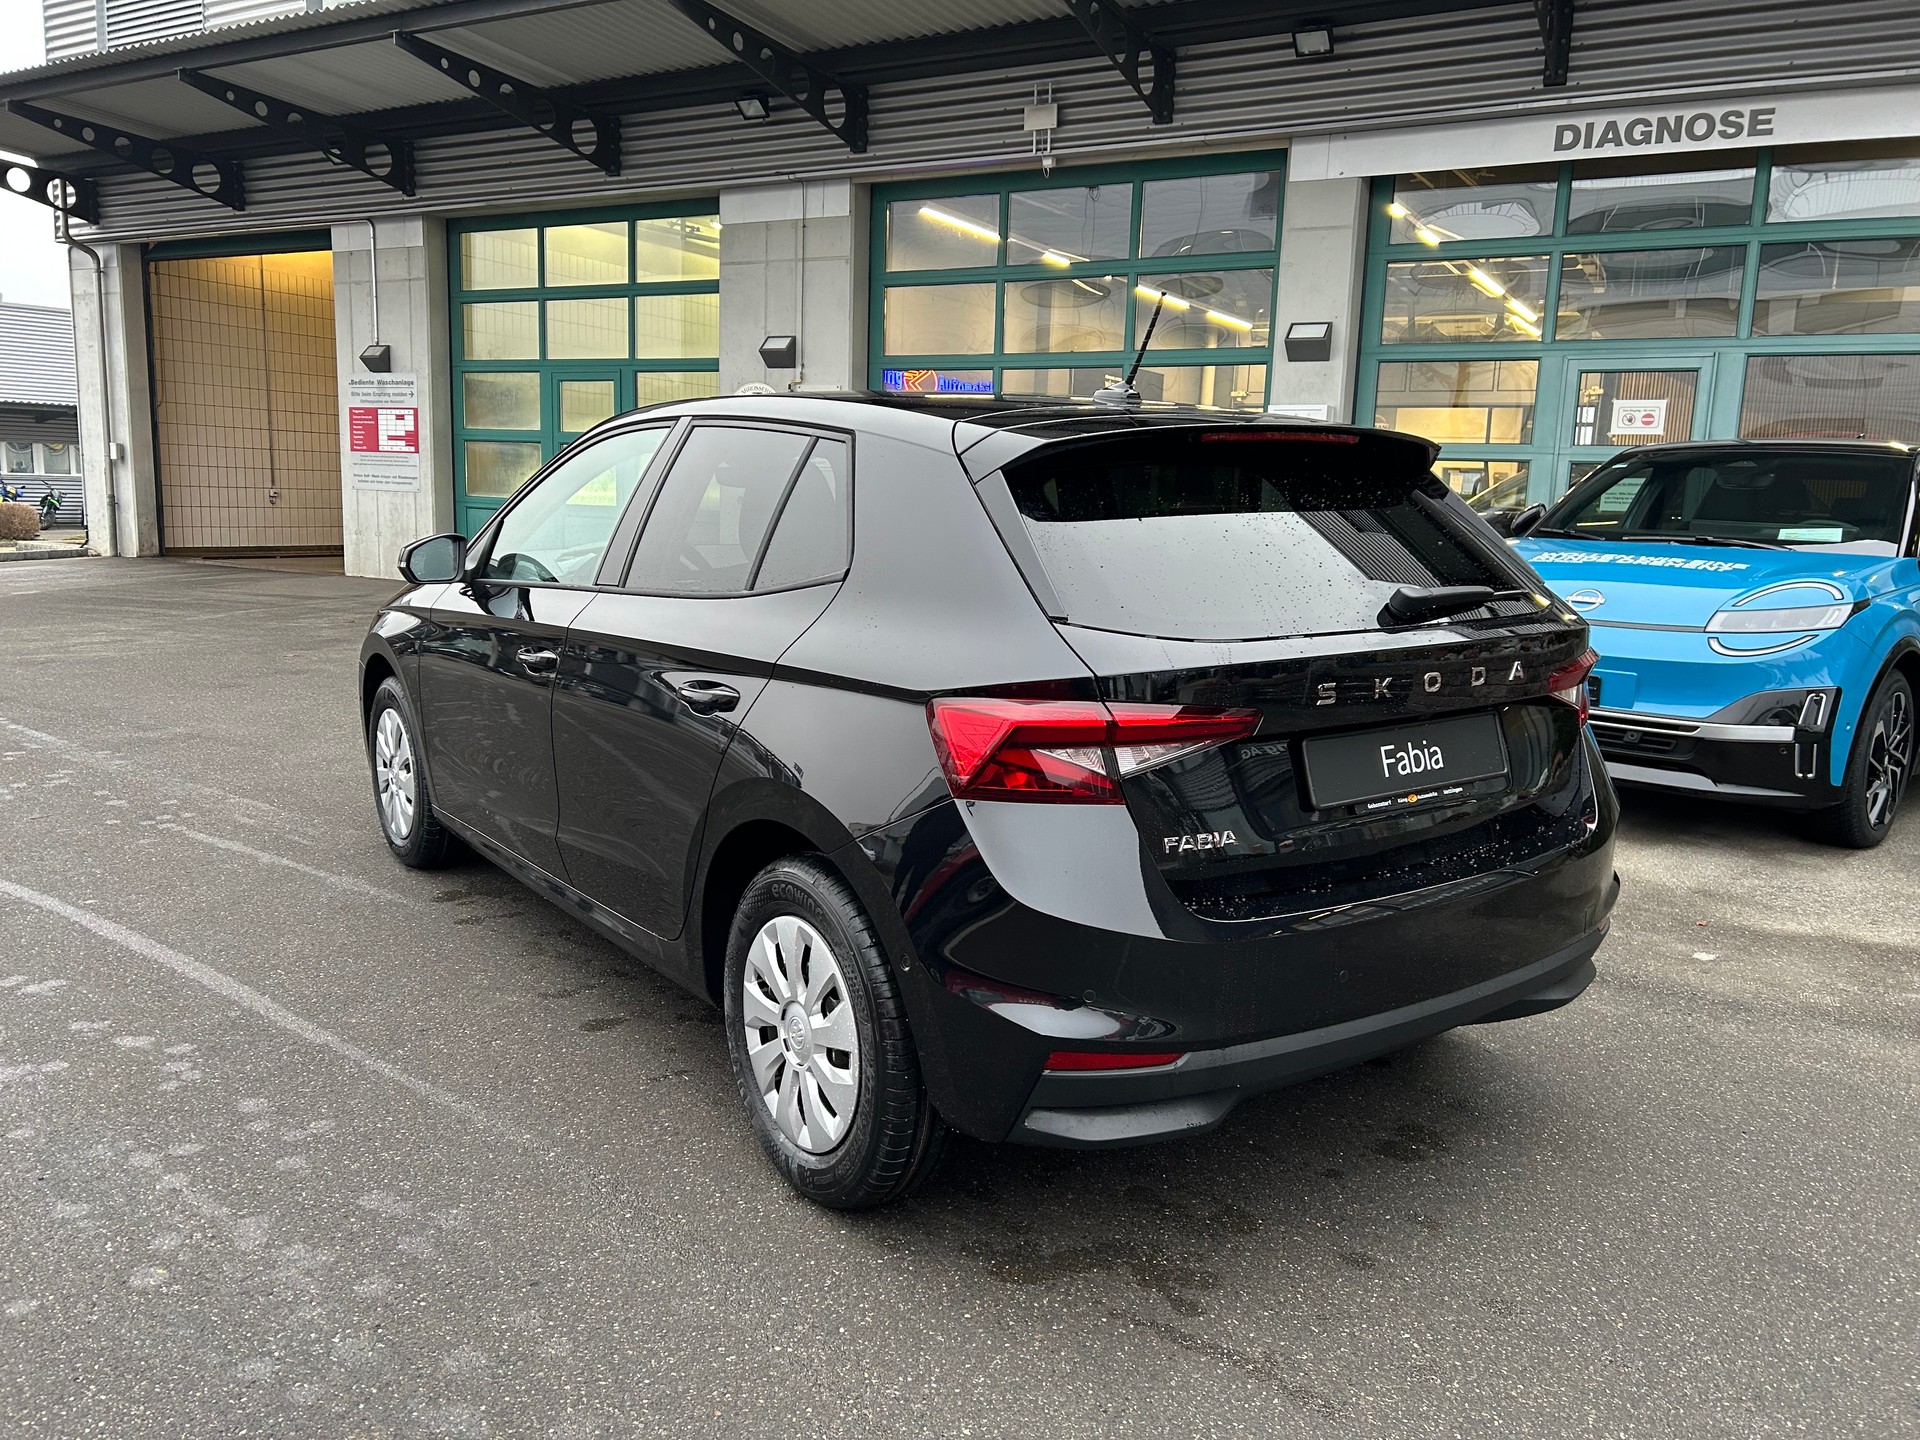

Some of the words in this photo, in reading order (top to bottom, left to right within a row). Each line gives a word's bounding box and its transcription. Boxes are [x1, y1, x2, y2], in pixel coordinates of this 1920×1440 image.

[1554, 107, 1776, 151] DIAGNOSE
[376, 379, 415, 387] Waschanlage
[1380, 740, 1444, 778] Fabia
[1163, 830, 1239, 854] FABIA
